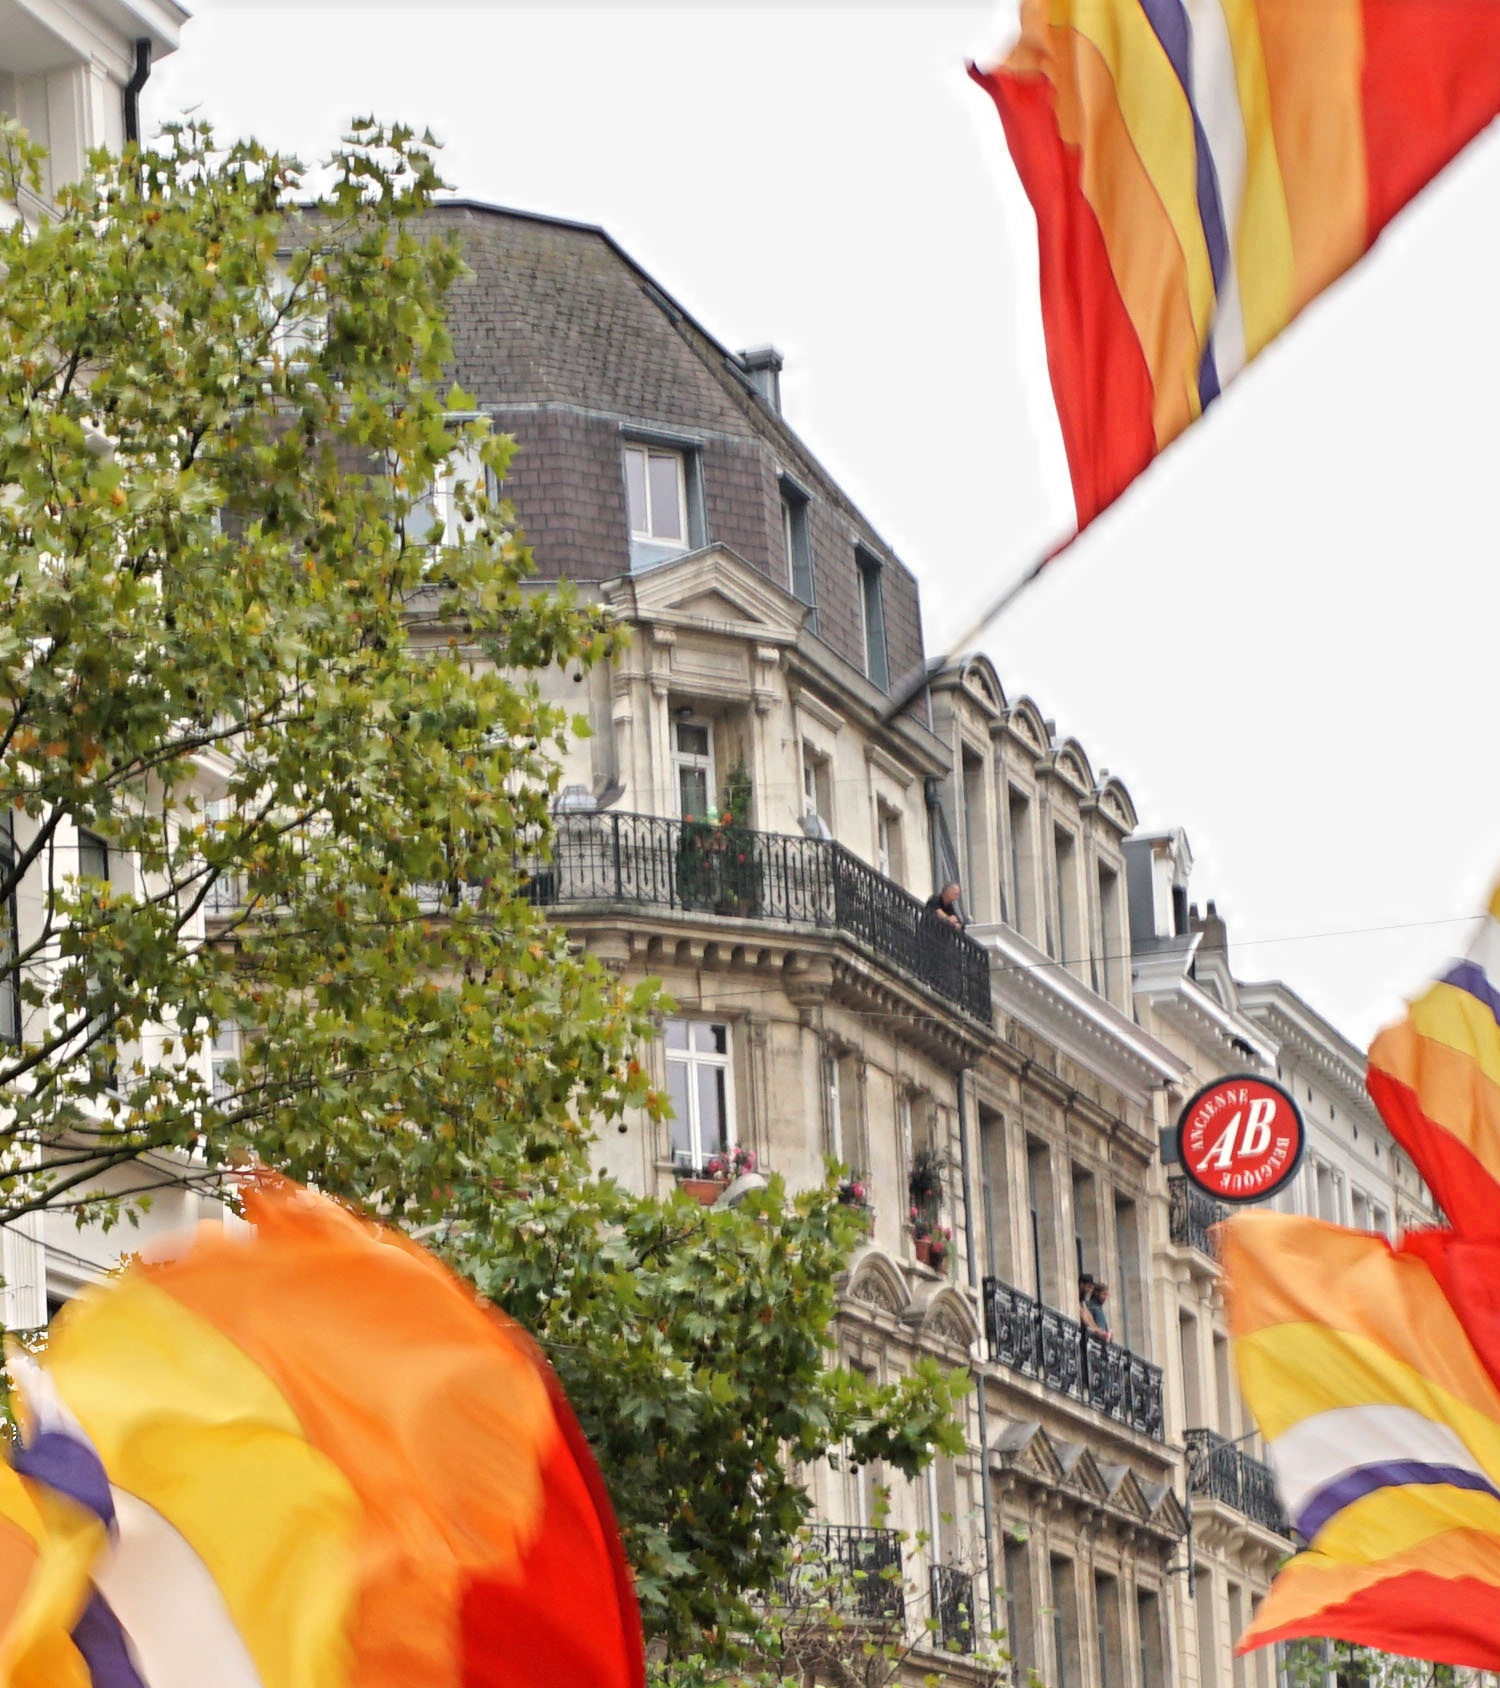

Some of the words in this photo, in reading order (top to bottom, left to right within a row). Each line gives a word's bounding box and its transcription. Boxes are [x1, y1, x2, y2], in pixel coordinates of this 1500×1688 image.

[1190, 1088, 1249, 1151] ANCIENNE
[1196, 1098, 1277, 1172] AB
[1220, 1137, 1290, 1191] BELGIQUE
